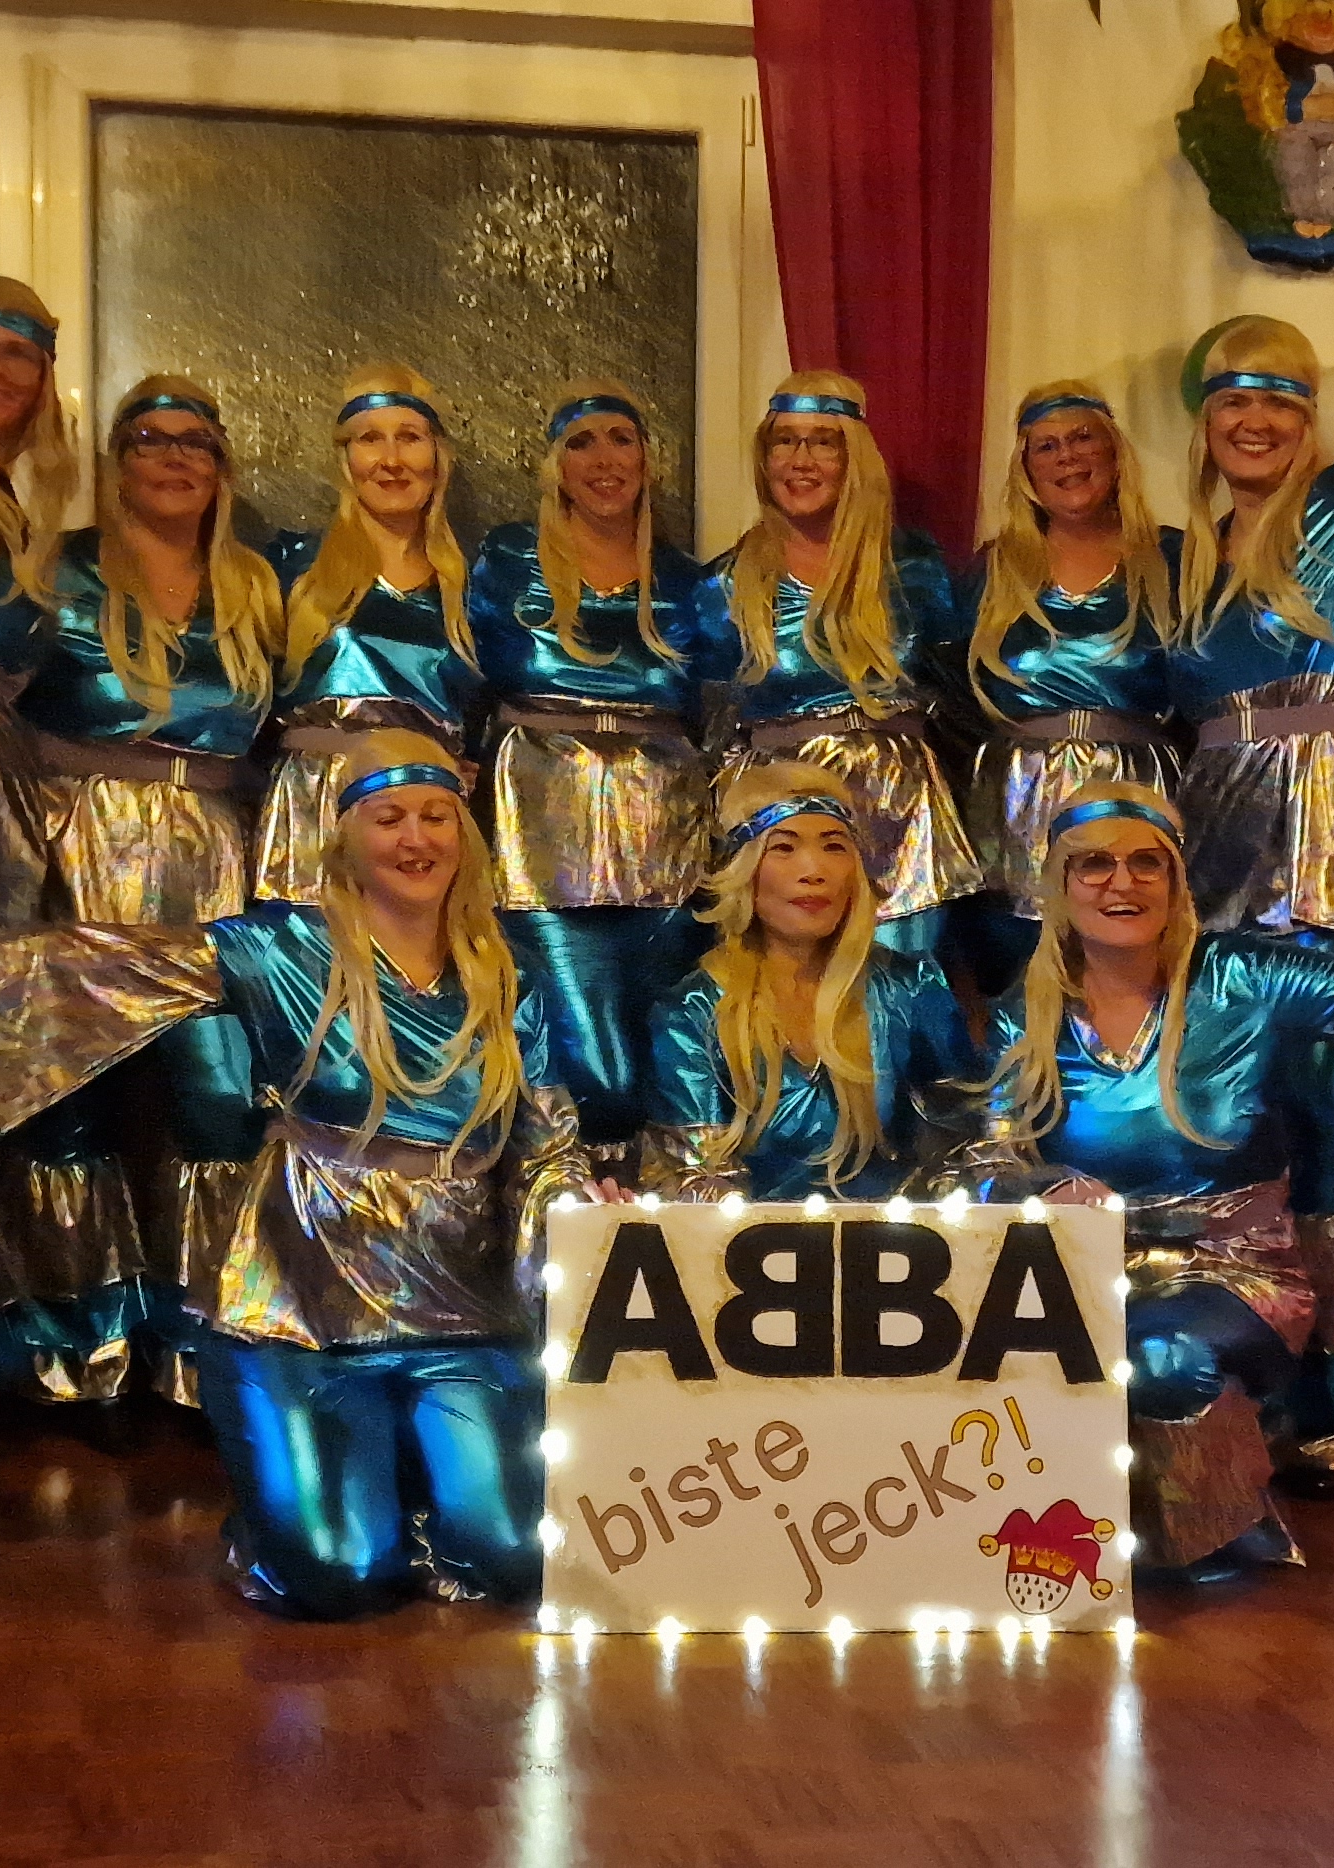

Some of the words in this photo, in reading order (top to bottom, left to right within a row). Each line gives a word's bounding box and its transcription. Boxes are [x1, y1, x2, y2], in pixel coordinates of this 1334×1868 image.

[568, 1221, 1106, 1384] ABBA
[577, 1419, 809, 1575] biste
[773, 1396, 1044, 1608] jeck?!
